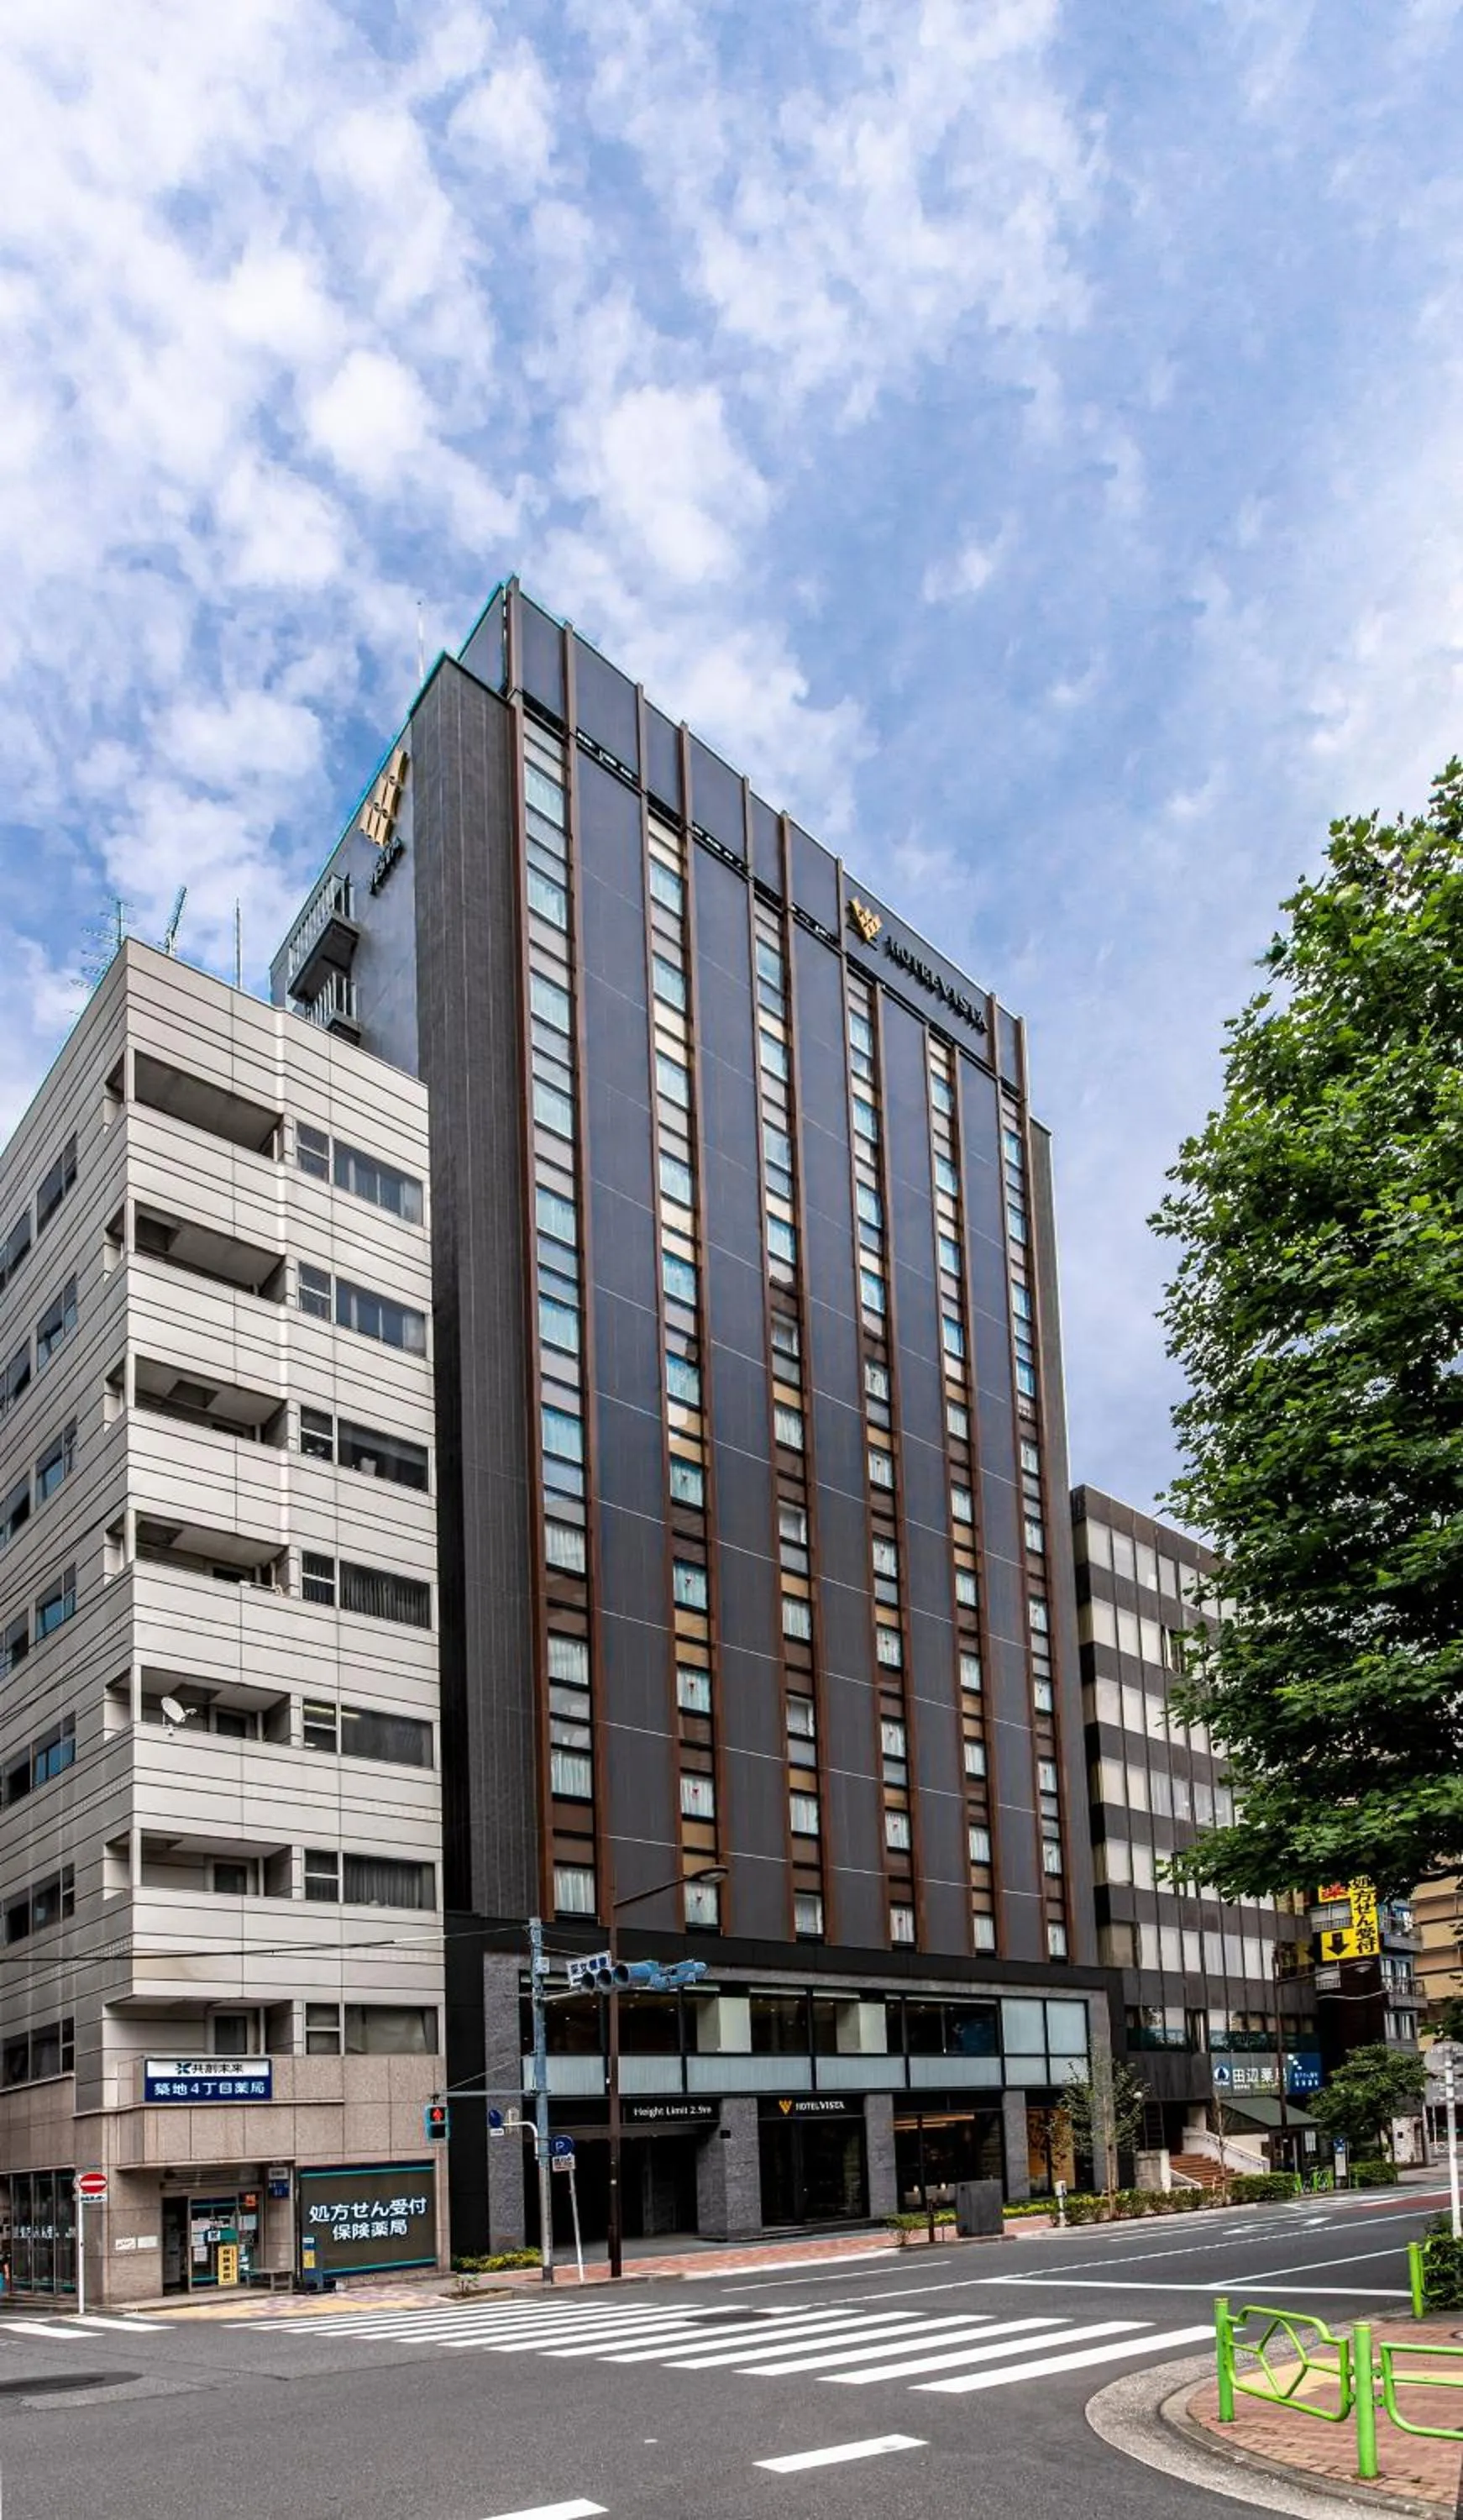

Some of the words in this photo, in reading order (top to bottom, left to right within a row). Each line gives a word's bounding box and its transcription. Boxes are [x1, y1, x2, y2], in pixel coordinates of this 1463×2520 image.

[155, 2082, 265, 2096] 築地4丁目薬局
[309, 2197, 427, 2223] 処方せん受付
[333, 2218, 408, 2242] 保険薬局
